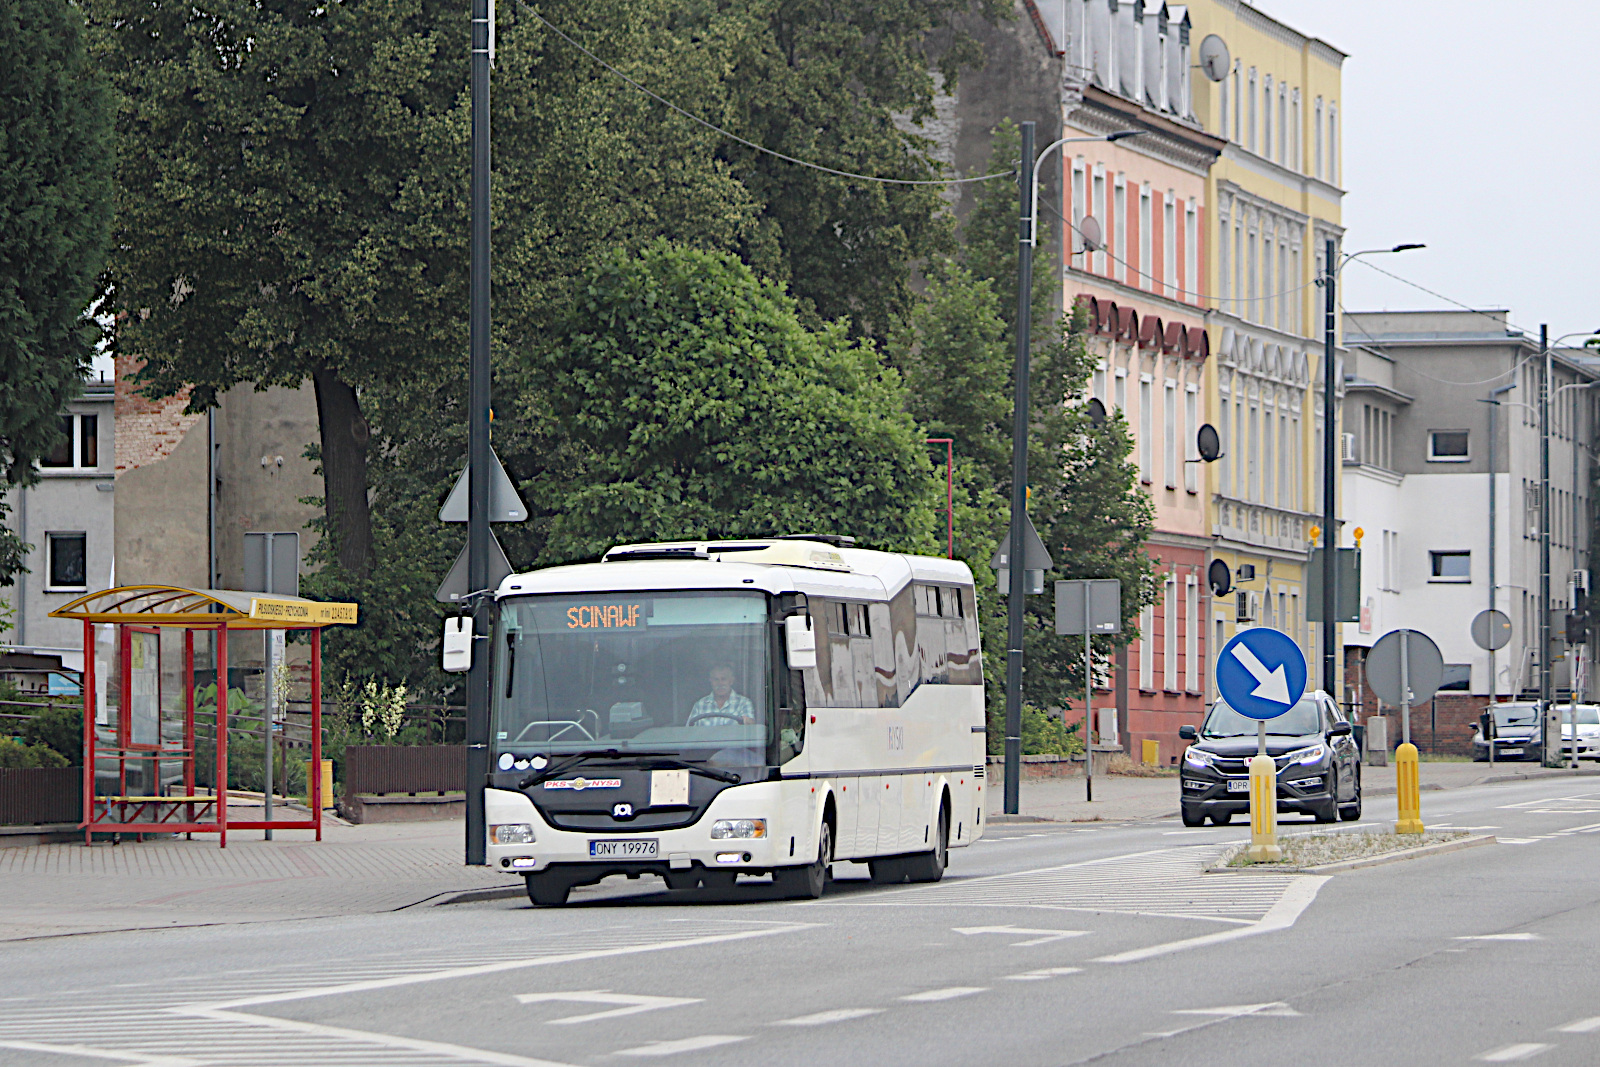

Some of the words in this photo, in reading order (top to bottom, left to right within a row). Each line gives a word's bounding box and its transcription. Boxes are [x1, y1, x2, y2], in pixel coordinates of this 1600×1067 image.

[1232, 781, 1248, 790] OPR
[596, 843, 618, 855] ONY
[622, 842, 656, 855] 19976
